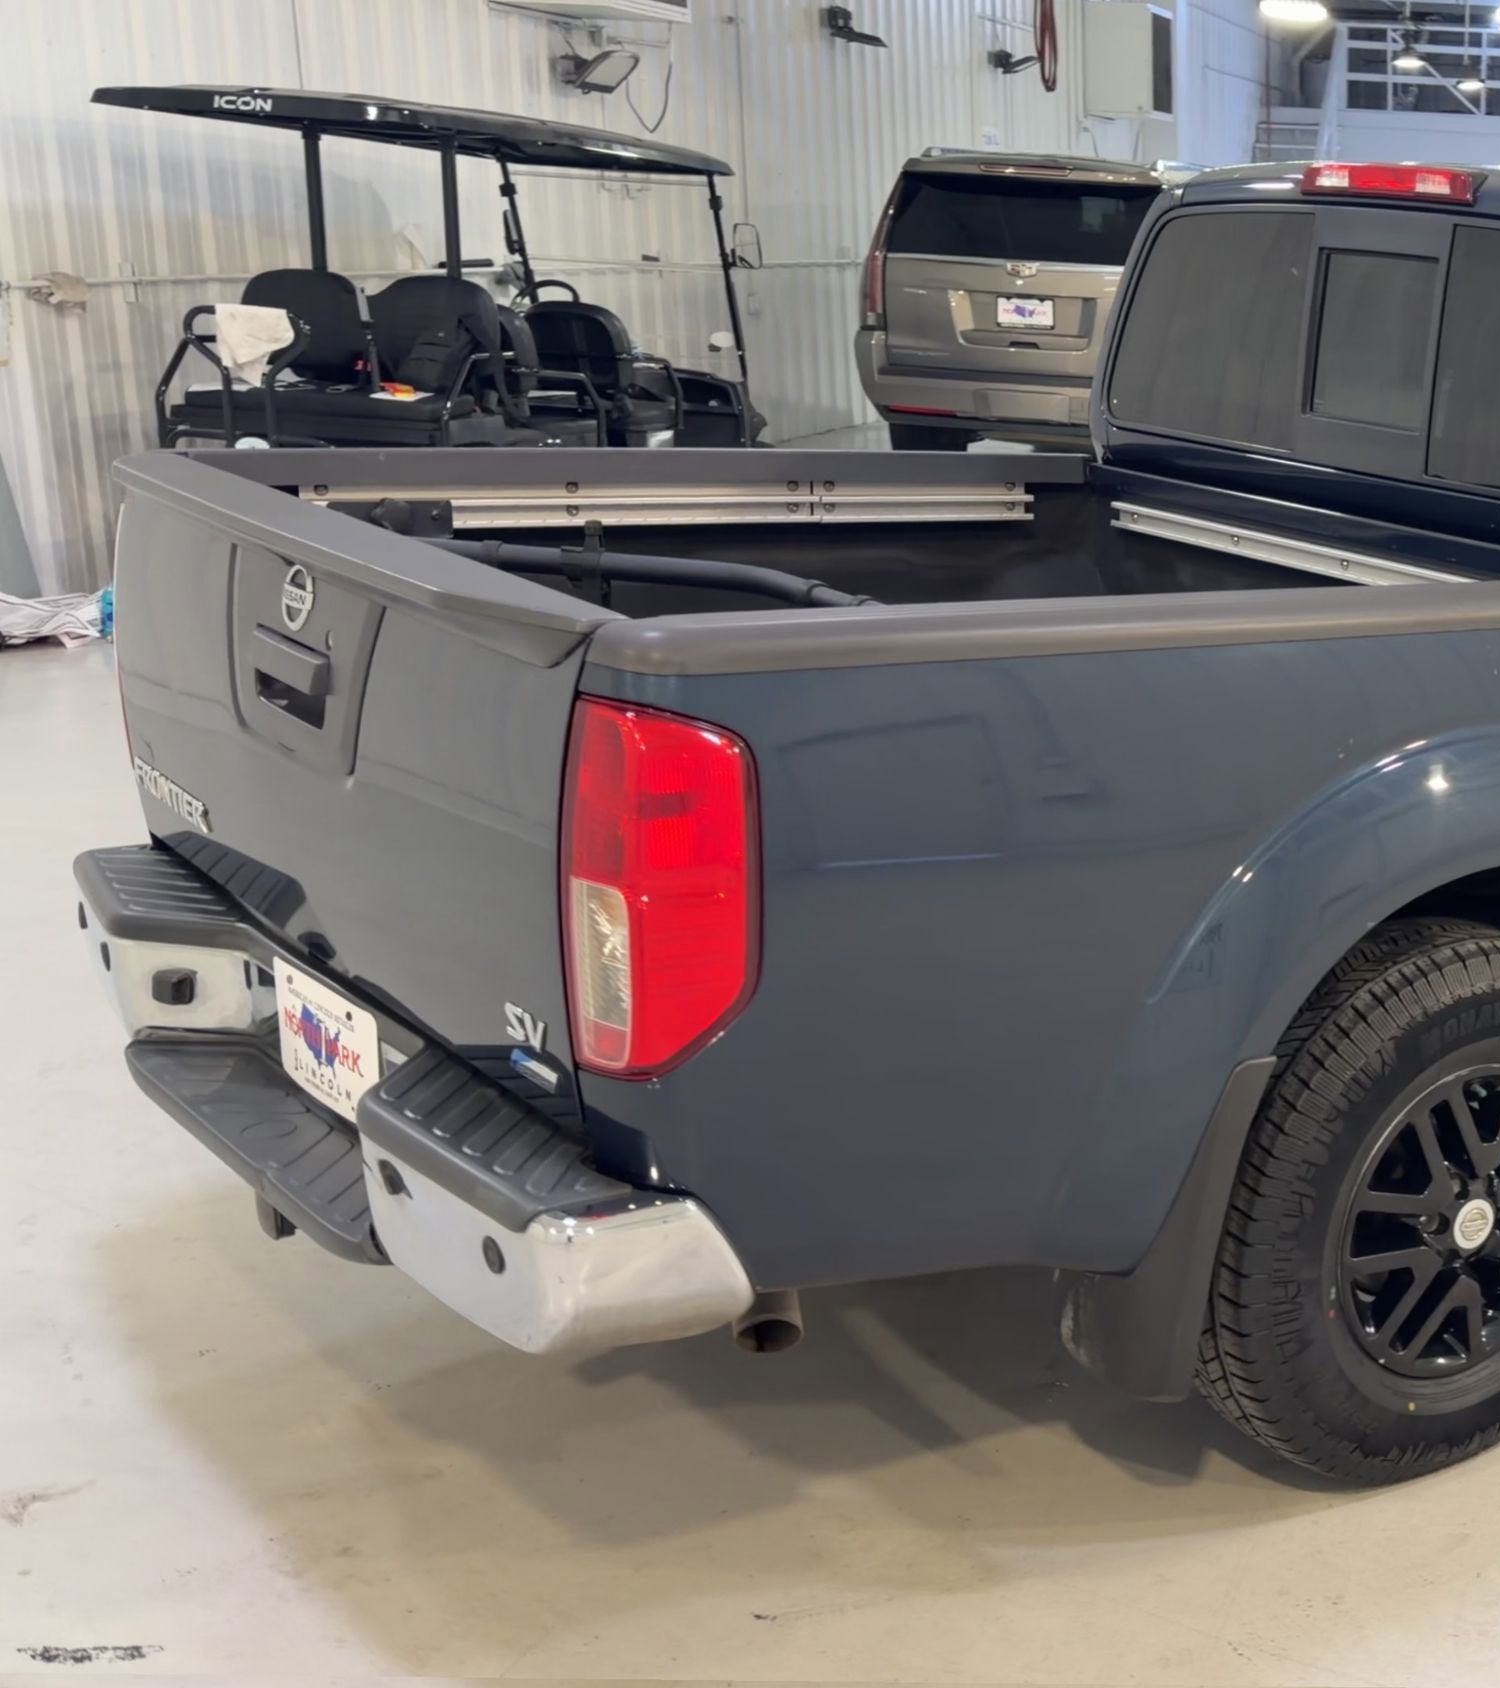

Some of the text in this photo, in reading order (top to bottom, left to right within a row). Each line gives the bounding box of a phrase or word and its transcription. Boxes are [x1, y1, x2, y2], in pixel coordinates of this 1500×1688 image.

[213, 94, 272, 112] ICON
[135, 755, 208, 832] FRONTIER
[504, 1001, 545, 1052] SV
[299, 1057, 351, 1101] LINCOLN
